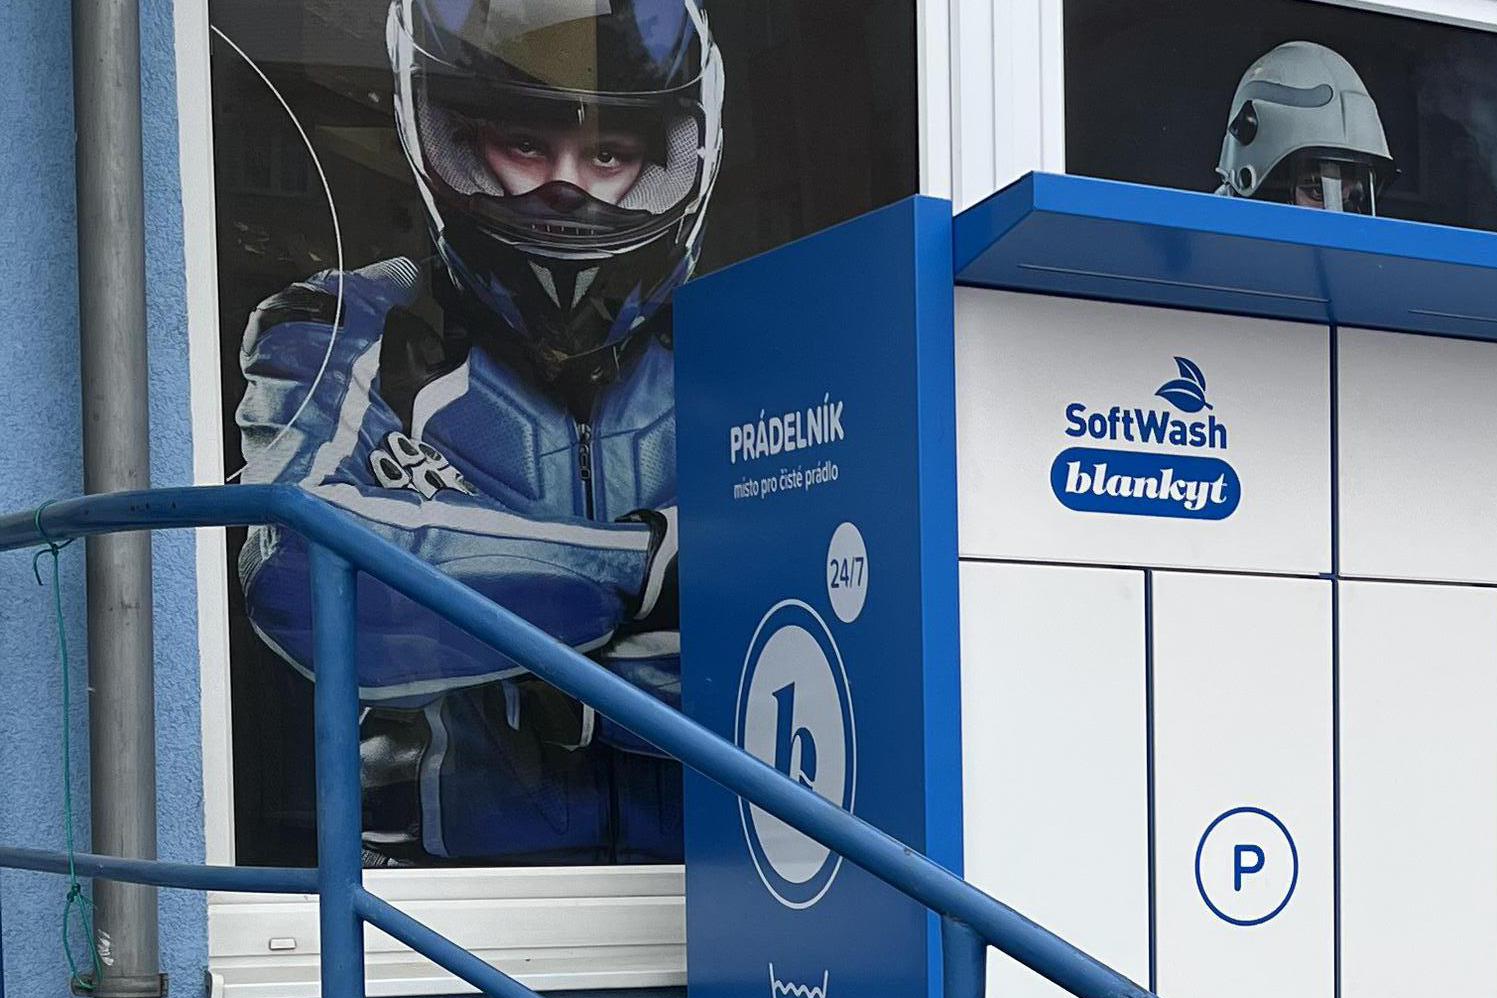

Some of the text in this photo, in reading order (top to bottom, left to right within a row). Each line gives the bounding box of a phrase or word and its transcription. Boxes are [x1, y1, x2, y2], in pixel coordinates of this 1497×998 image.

[730, 392, 844, 464] PRÁDELNÍK
[1065, 403, 1227, 449] SoftWash
[761, 477, 777, 499] pro
[805, 460, 838, 491] prádlo
[1065, 461, 1227, 510] blankyt
[830, 557, 864, 588] 24/7
[1234, 844, 1265, 891] P
